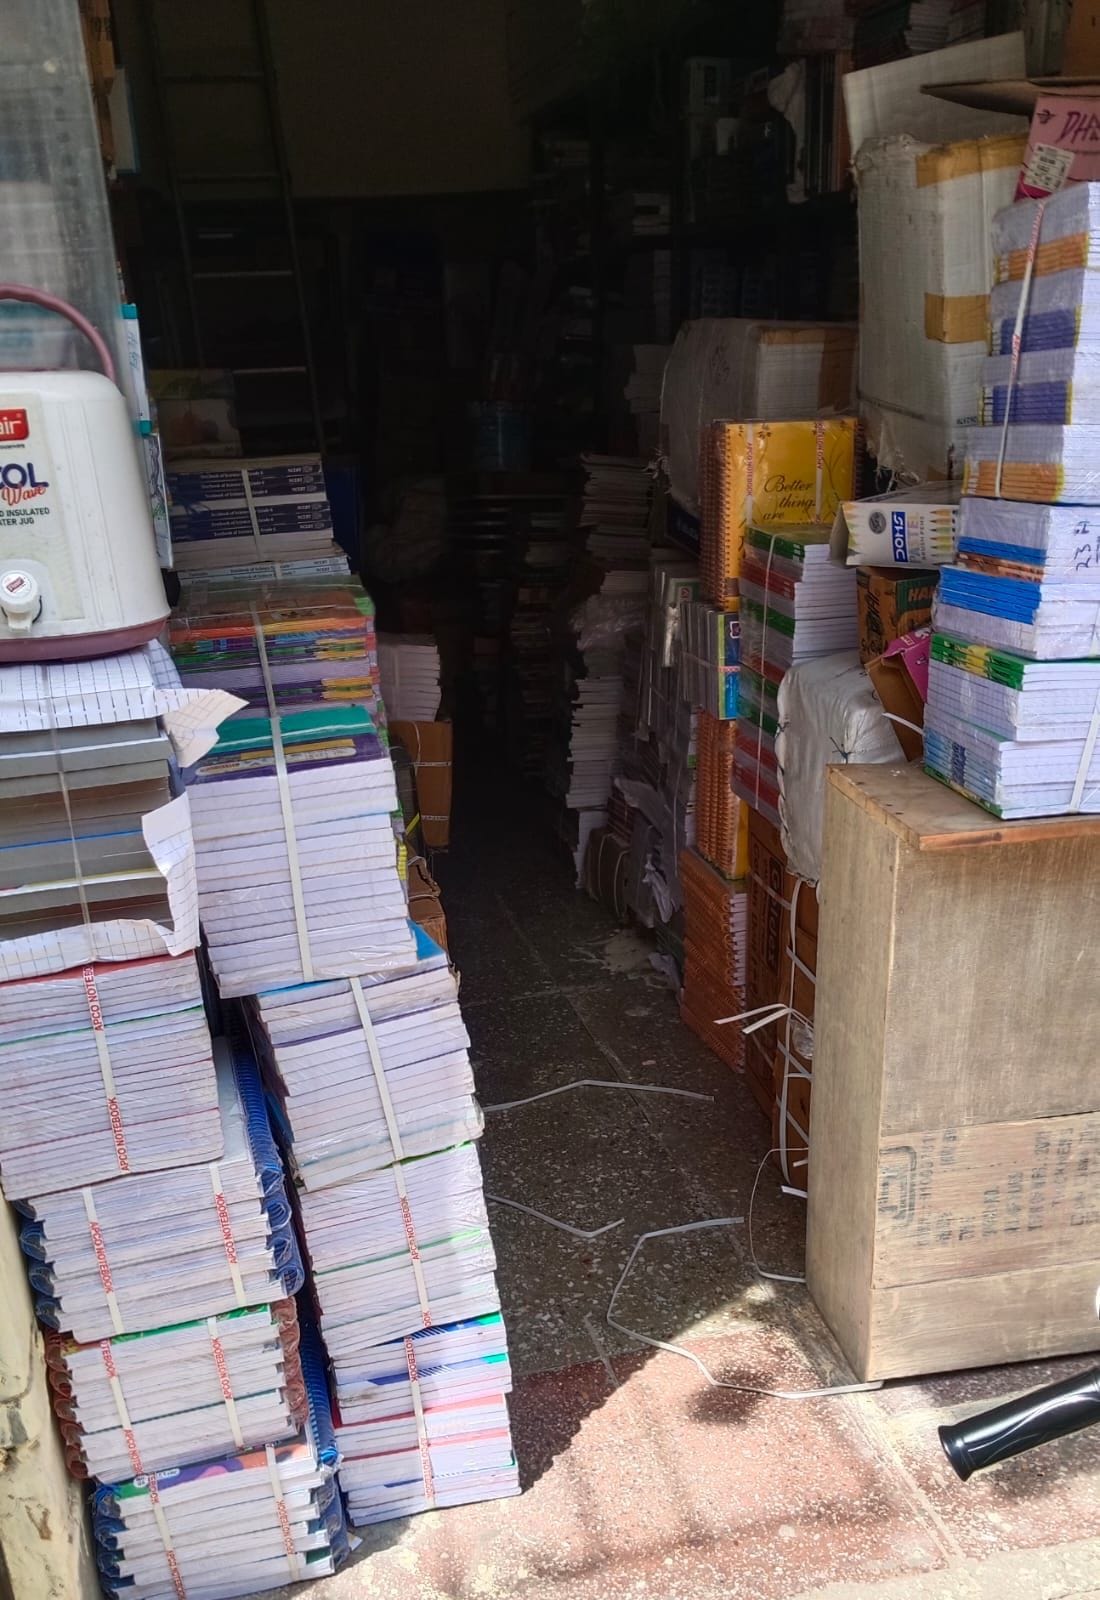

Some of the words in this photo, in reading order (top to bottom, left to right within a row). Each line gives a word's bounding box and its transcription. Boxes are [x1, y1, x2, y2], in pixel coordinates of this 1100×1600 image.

[764, 474, 813, 493] Better
[7, 507, 50, 517] INSULATED
[19, 517, 34, 525] JUG
[893, 514, 906, 560] DOMS
[83, 967, 97, 1004] NOTEBO
[90, 1004, 105, 1032] APCO
[108, 1096, 124, 1147] NOTEBOOK
[114, 1147, 129, 1172] APCO
[215, 1192, 231, 1241] NOTEBOOK
[399, 1195, 415, 1239] NOTEBOOK
[90, 1221, 105, 1247] APCO
[224, 1241, 238, 1264] APCO
[94, 1246, 113, 1294] NOTEBOOK
[102, 1339, 116, 1379] OTEBOOK
[212, 1337, 228, 1379] NOTEBOOK
[222, 1379, 233, 1401] APCO
[124, 1428, 137, 1449] APCO
[128, 1449, 143, 1475] NOTEBO
[422, 1459, 434, 1498] NOTEBOOK
[276, 1500, 292, 1537] NOTEBOOK
[283, 1537, 295, 1555] APCO
